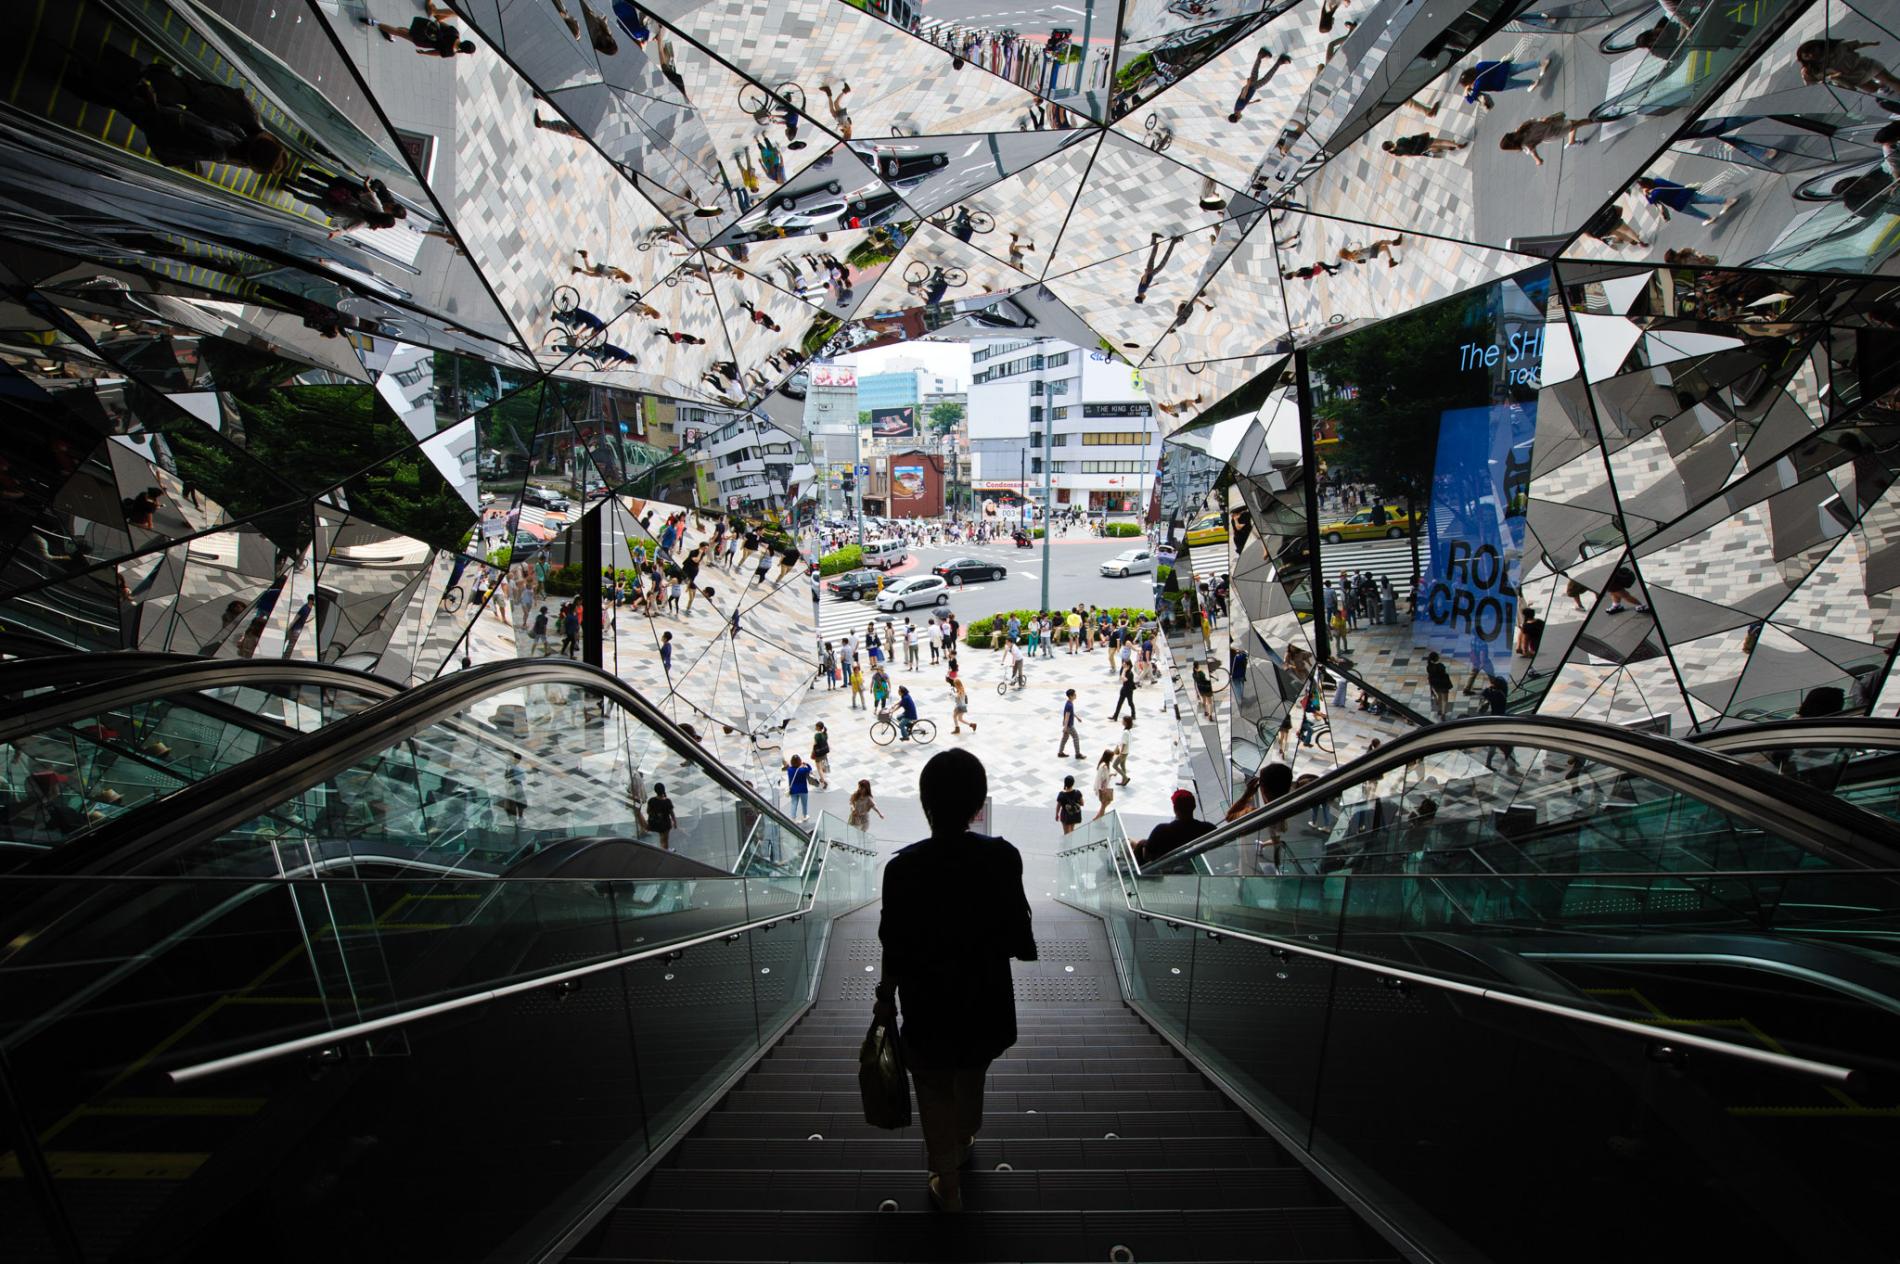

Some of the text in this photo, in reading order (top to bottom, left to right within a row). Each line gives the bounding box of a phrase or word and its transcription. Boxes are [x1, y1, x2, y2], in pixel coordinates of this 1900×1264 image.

[1460, 342, 1500, 372] The
[1510, 366, 1541, 385] TOK
[1429, 583, 1513, 650] CRO
